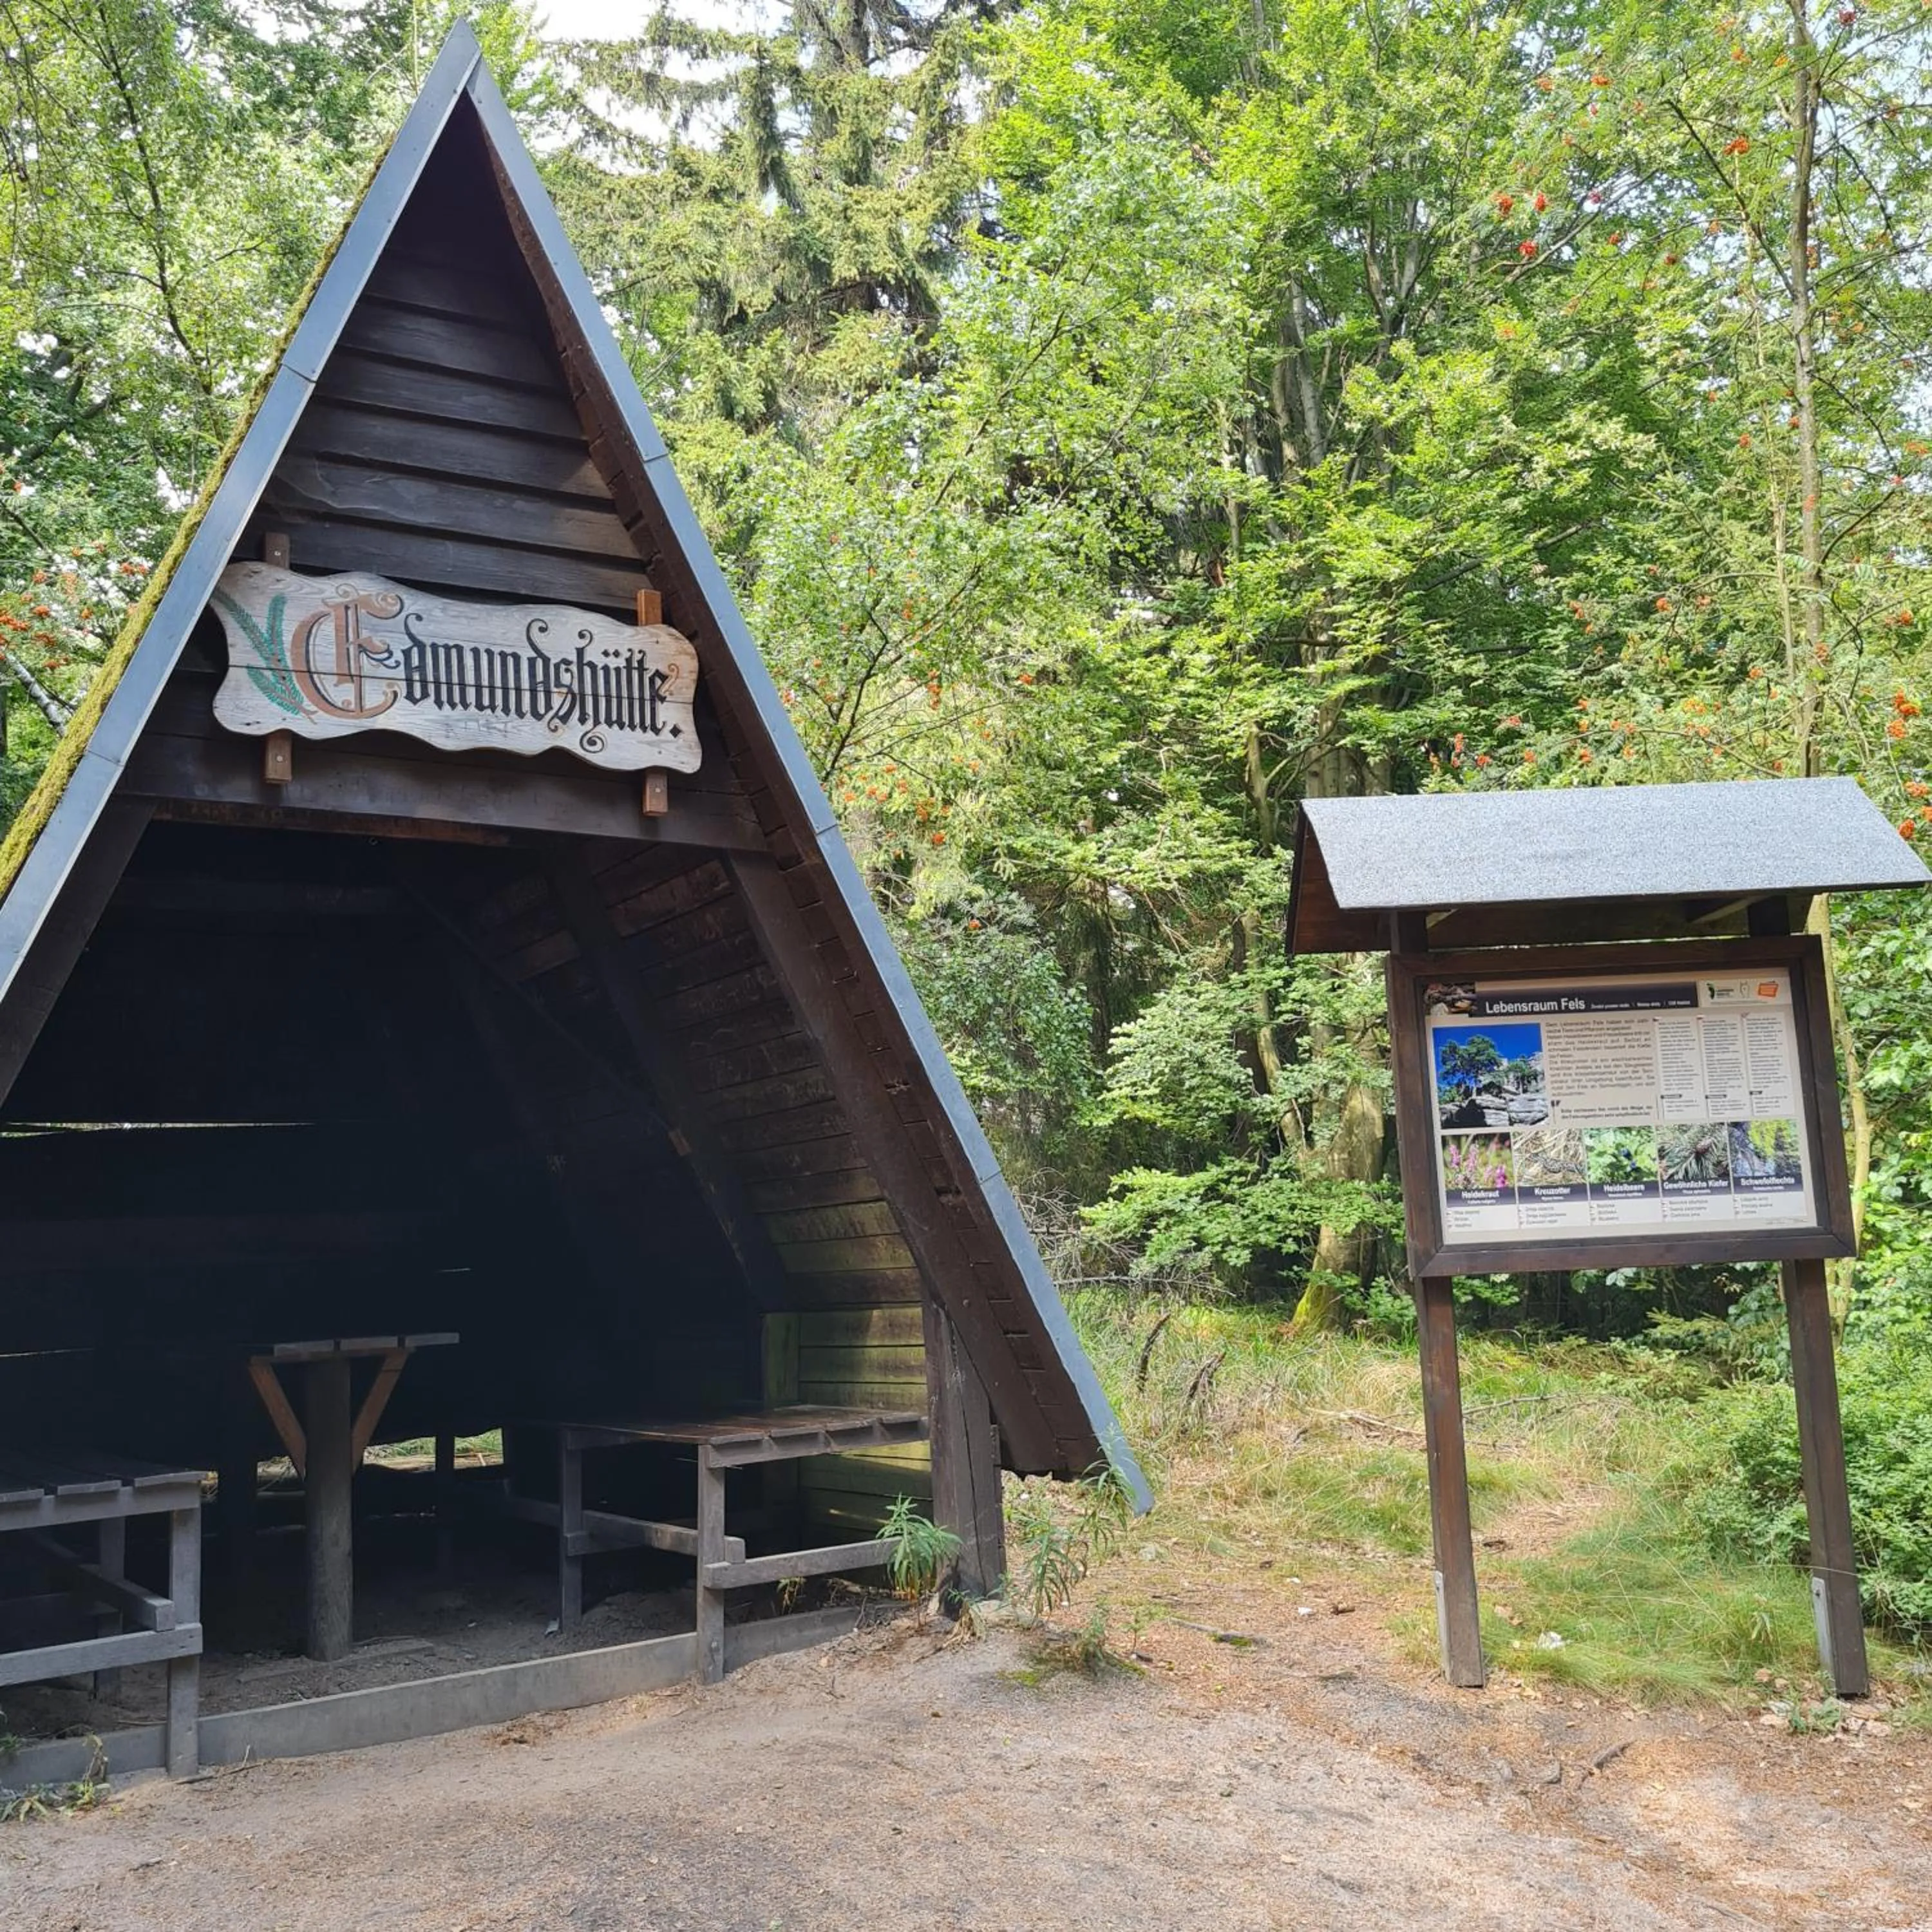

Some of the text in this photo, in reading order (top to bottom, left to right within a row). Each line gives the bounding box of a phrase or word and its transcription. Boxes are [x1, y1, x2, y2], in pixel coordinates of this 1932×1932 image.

[1486, 1000, 1558, 1014] Lebensraum
[1560, 998, 1586, 1010] Fels
[1663, 1179, 1728, 1189] Gewöhnliche Kiefer
[1461, 1189, 1500, 1198] Heidekraut
[1534, 1187, 1571, 1196] Kreuzotter
